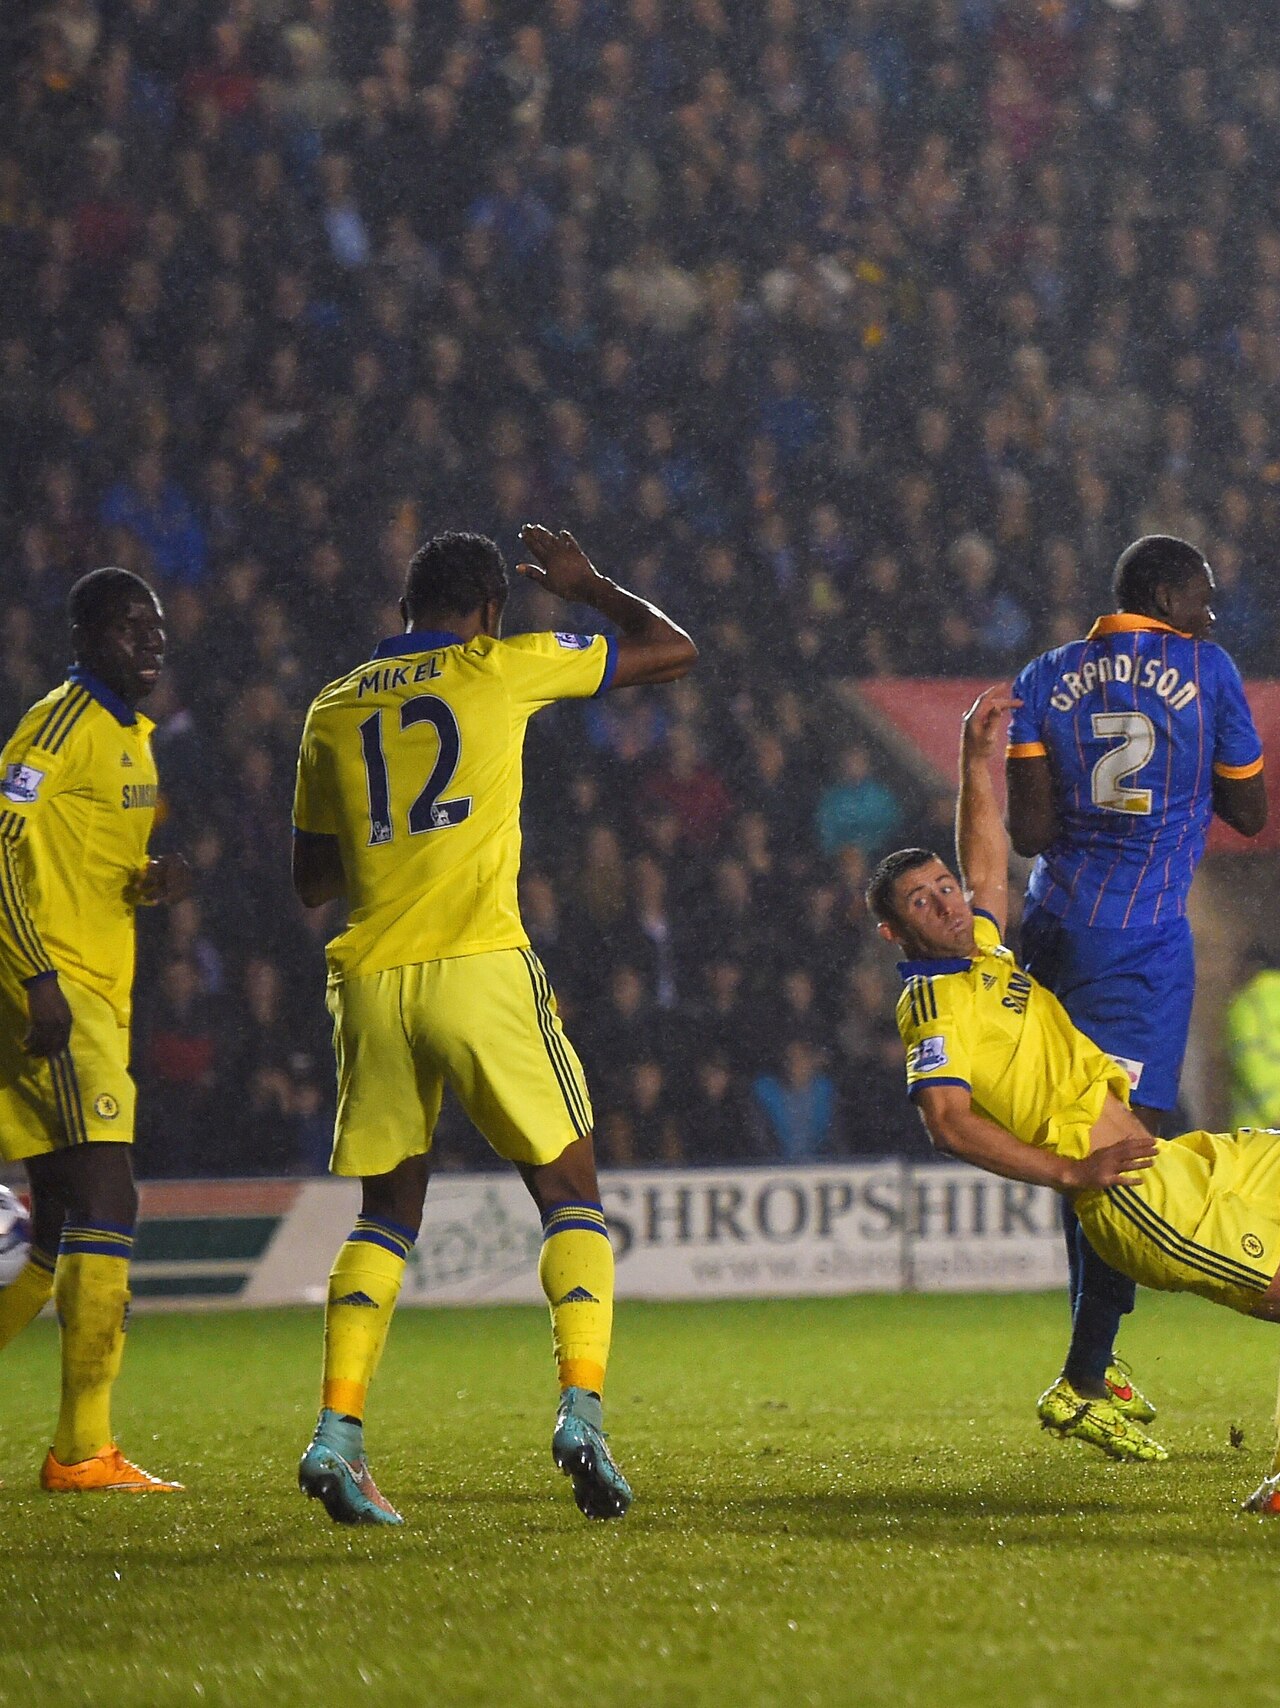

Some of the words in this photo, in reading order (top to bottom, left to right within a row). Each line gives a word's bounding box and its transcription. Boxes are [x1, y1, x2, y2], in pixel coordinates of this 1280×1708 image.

[357, 656, 443, 699] MIKEL
[1050, 653, 1199, 712] GRANDISON
[357, 693, 474, 847] 12
[1091, 711, 1156, 816] 2
